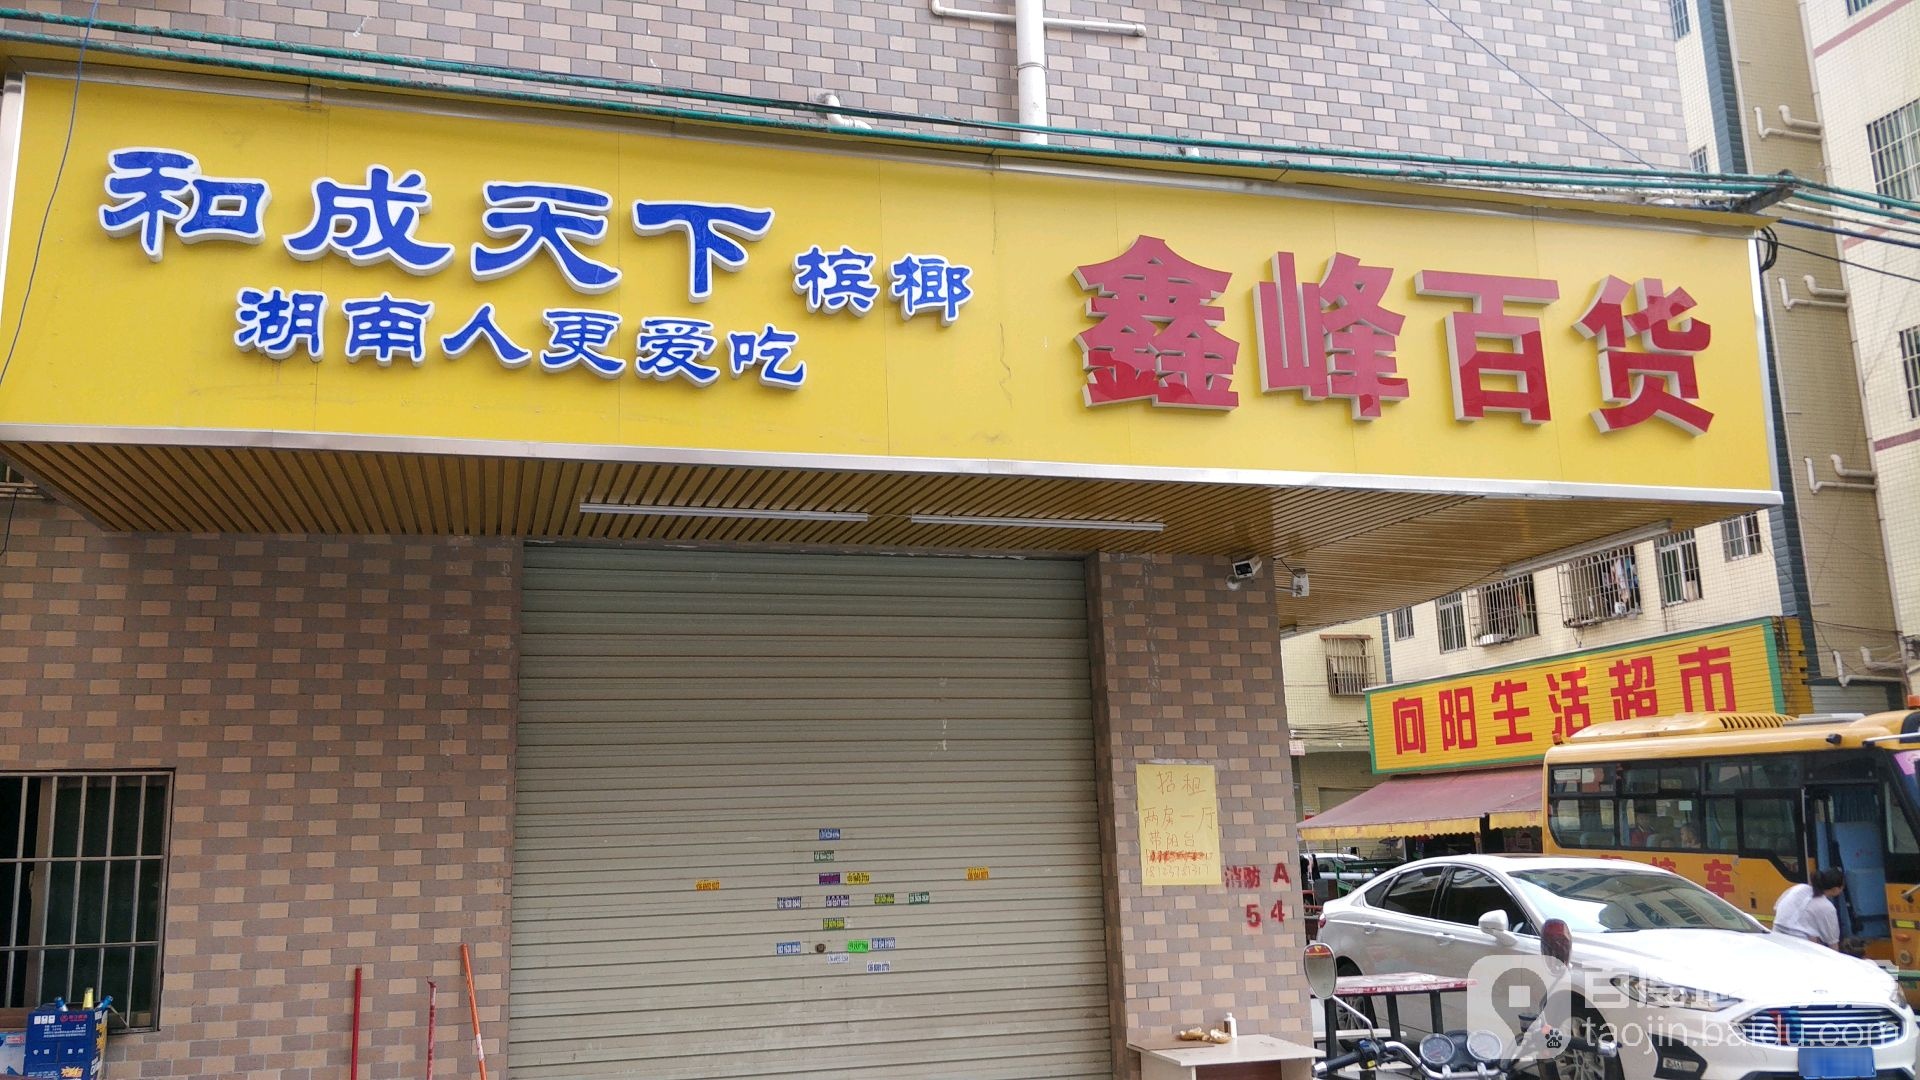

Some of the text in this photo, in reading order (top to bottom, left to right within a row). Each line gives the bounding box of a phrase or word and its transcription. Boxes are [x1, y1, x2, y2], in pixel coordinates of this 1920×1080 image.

[98, 146, 975, 327] 和成天下 槟榔
[234, 286, 807, 391] 湖南人更爱吃
[1072, 234, 1716, 438] 鑫峰百货
[1392, 645, 1737, 756] 向阳生活超市
[1142, 804, 1216, 833] 两房一厅
[1156, 770, 1207, 796] 招租
[1273, 862, 1290, 884] A
